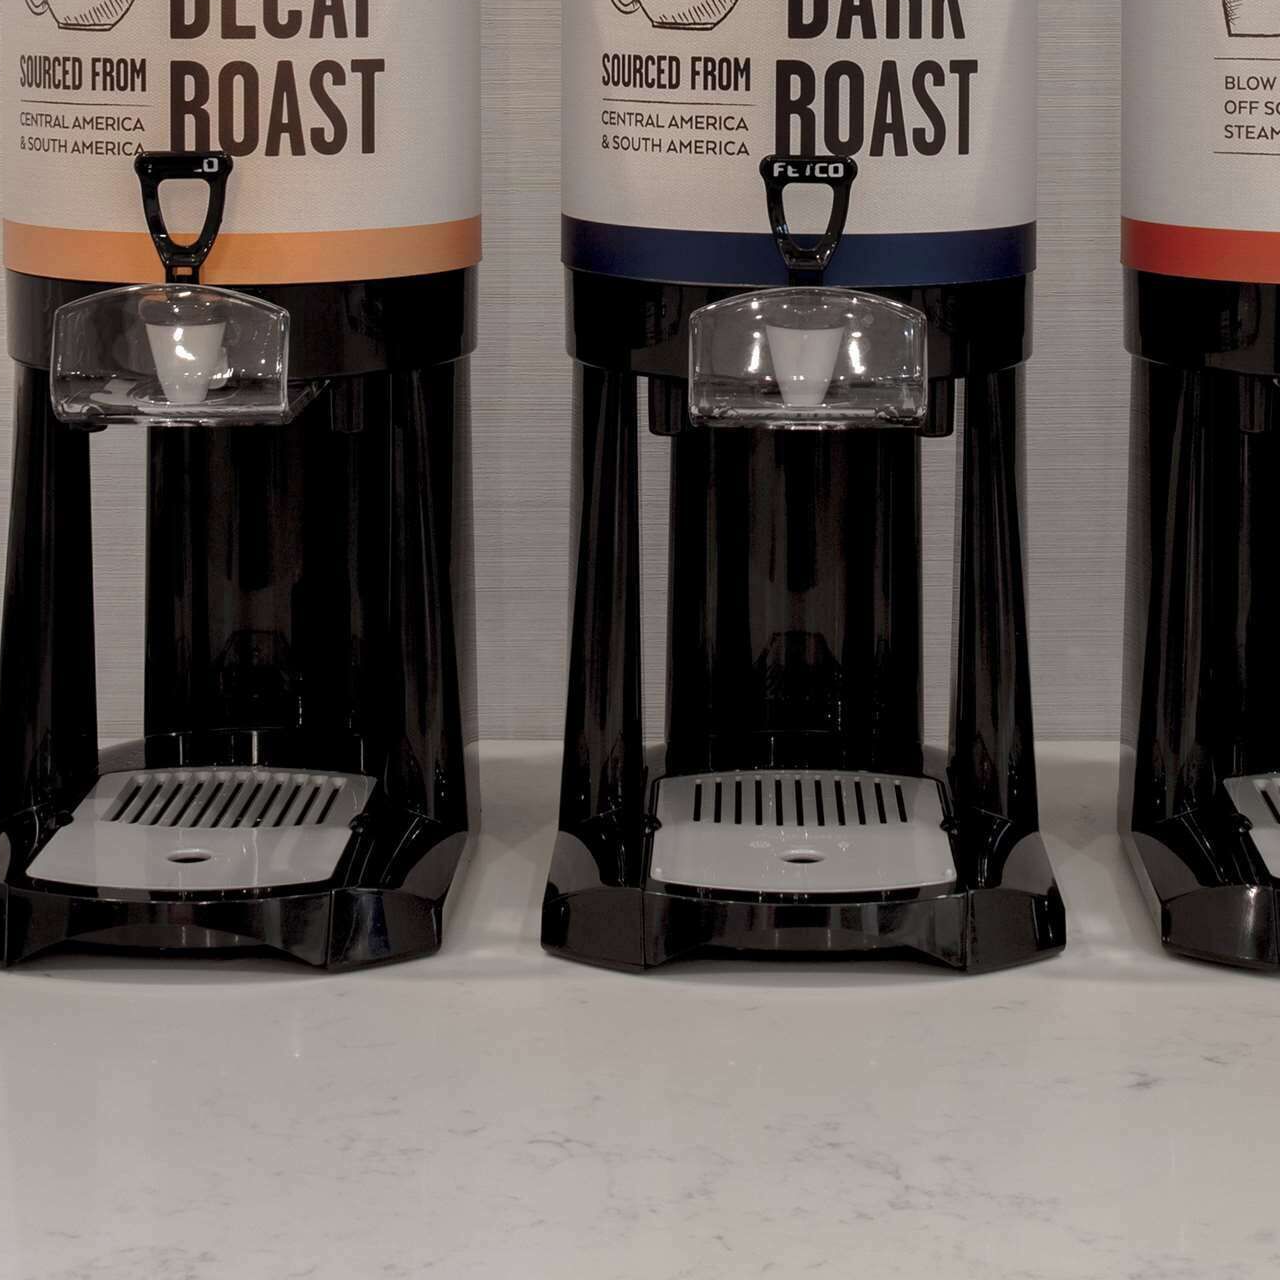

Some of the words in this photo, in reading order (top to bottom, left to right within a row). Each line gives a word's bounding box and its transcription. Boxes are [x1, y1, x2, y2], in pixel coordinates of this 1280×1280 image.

[20, 55, 82, 90] SOURCED
[91, 57, 146, 92] FROM
[602, 53, 680, 90] SOURCED
[691, 56, 751, 92] FROM
[1225, 76, 1277, 91] BLOW
[169, 59, 385, 156] ROAST
[775, 59, 978, 157] ROAST
[1224, 100, 1261, 116] OFF
[20, 112, 69, 129] CENTRAL
[72, 116, 145, 132] AMERICA
[601, 109, 665, 129] CENTRAL
[668, 114, 749, 131] AMERICA
[20, 136, 26, 150] &
[28, 137, 68, 153] SOUTH
[71, 141, 145, 156] AMERICA
[601, 135, 611, 151] &
[613, 136, 662, 154] SOUTH
[666, 138, 751, 156] AMERICA
